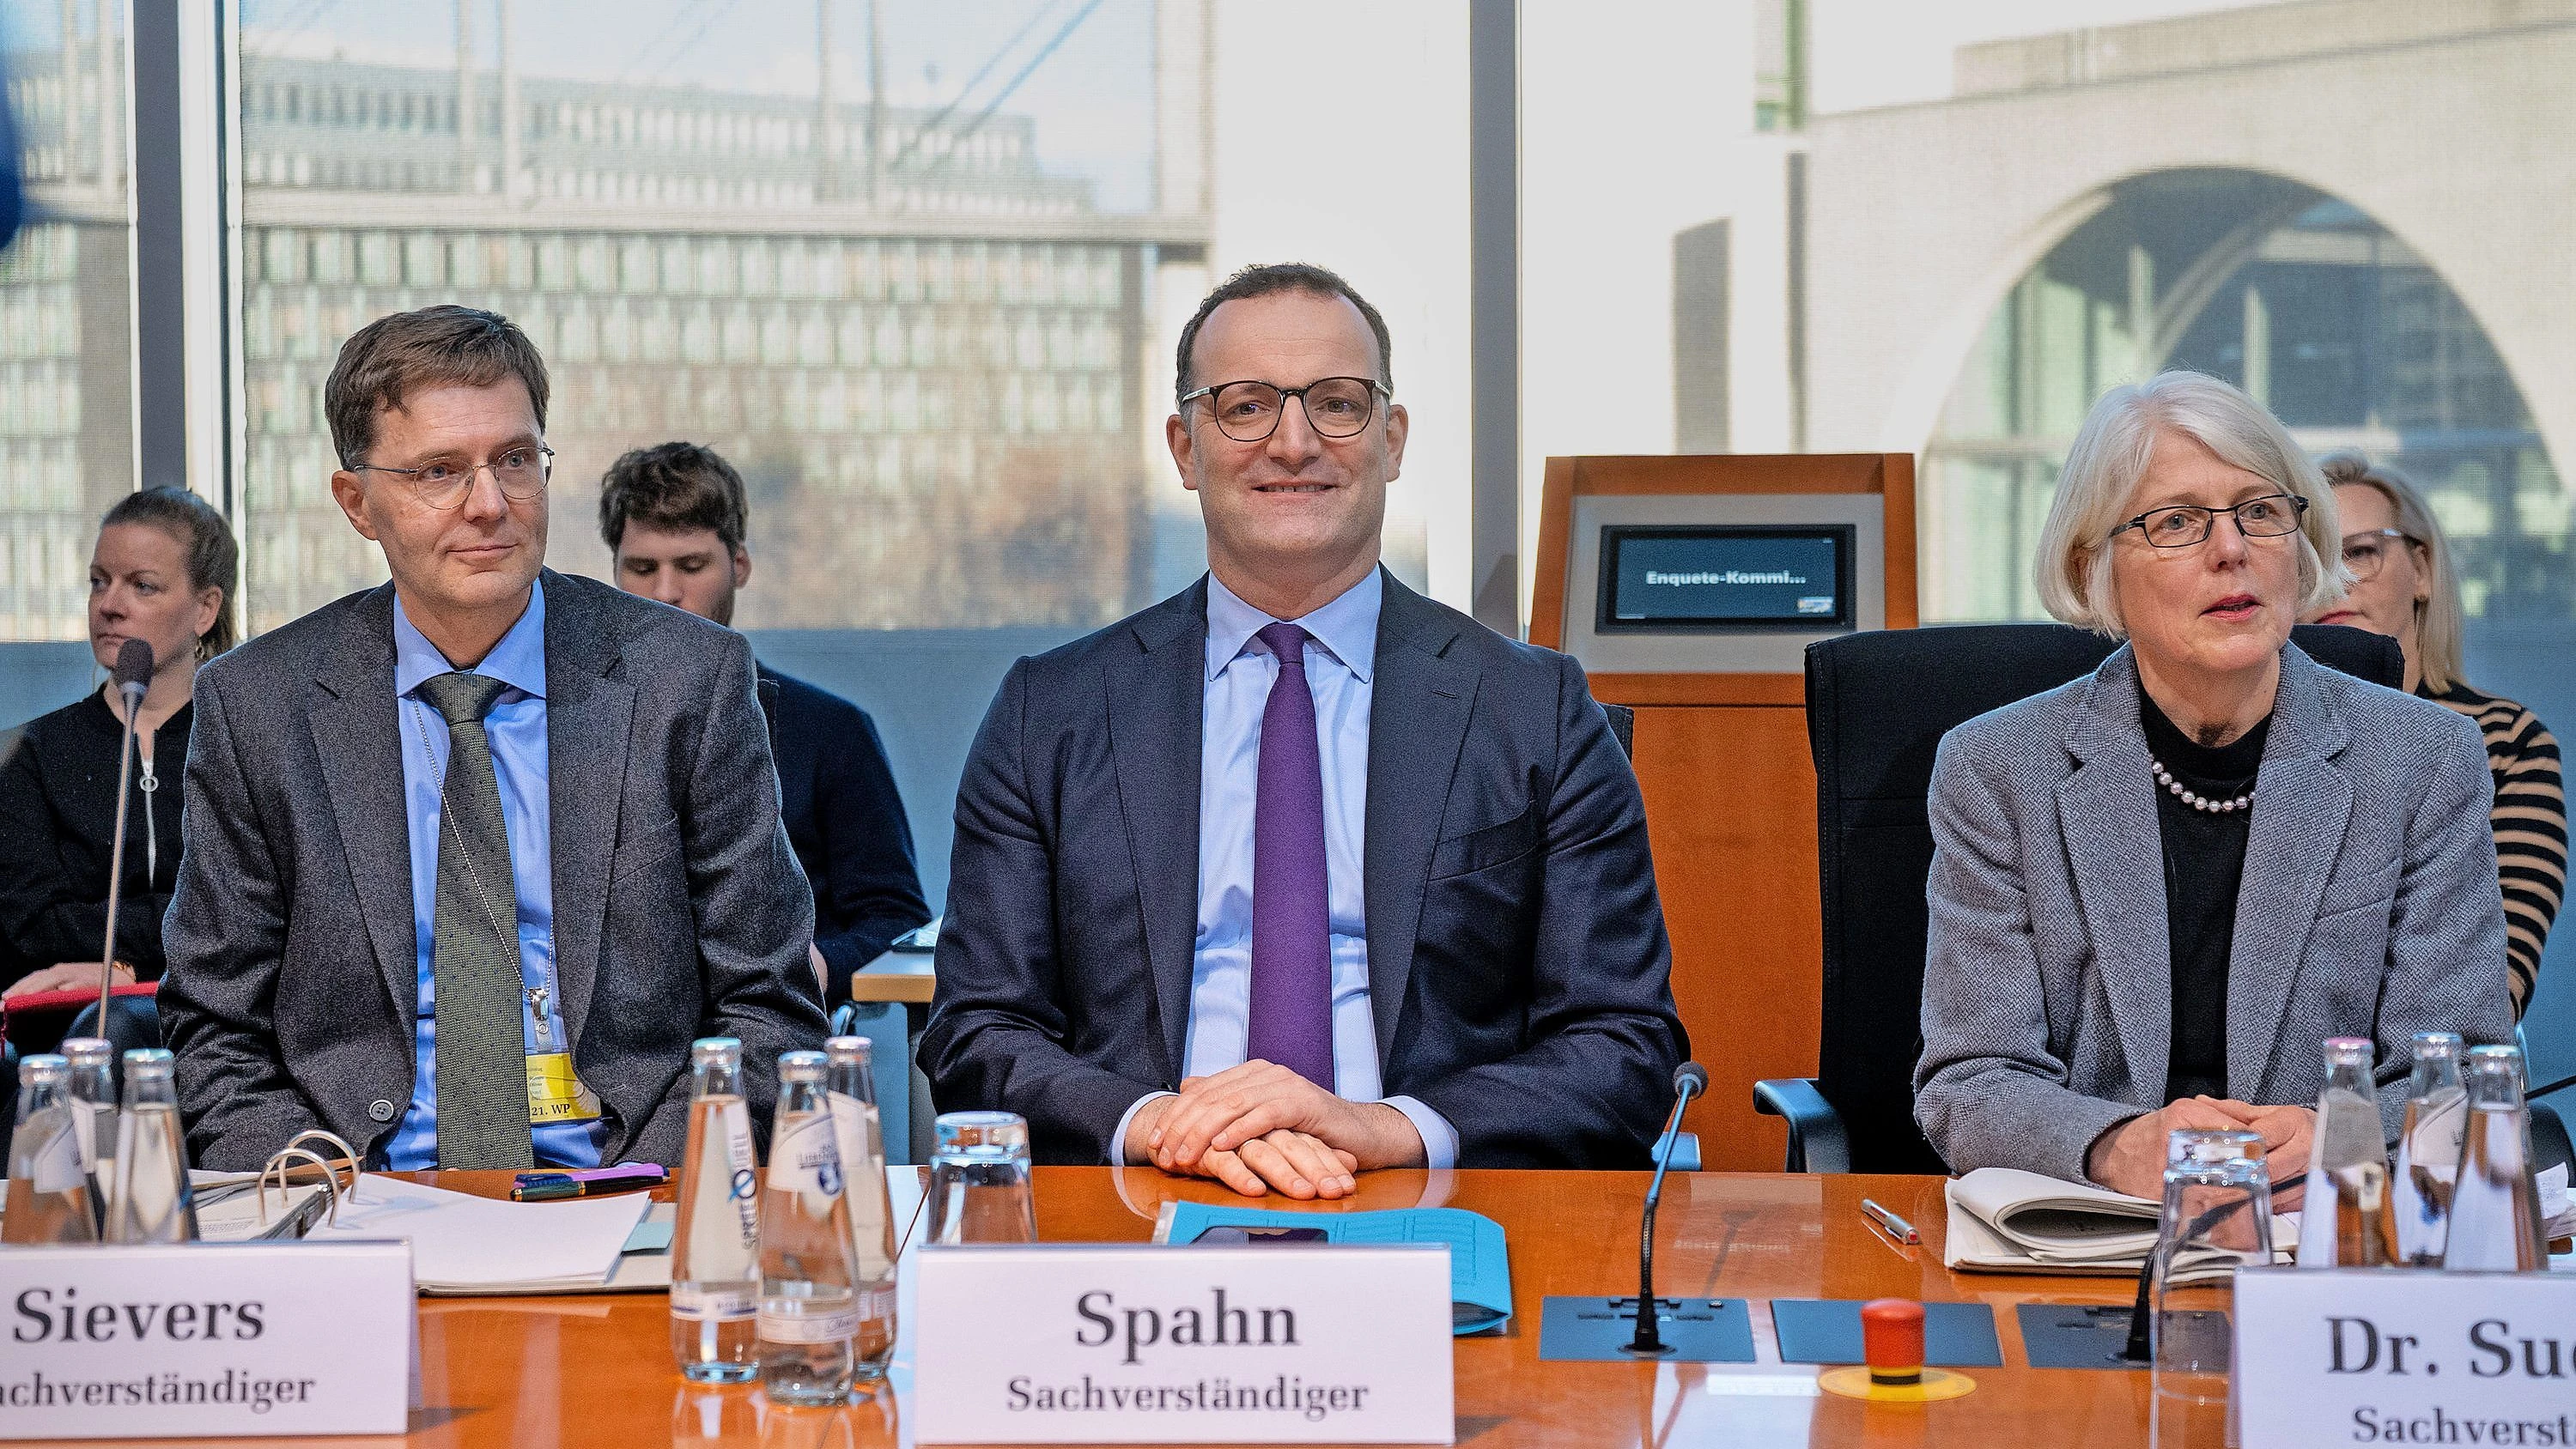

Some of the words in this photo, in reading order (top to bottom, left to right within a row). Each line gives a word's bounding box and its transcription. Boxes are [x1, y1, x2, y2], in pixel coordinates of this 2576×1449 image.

[1646, 570, 1806, 587] Enquete-Kommi...
[531, 1106, 549, 1116] 21.
[550, 1103, 571, 1114] WP
[13, 1286, 266, 1343] Sievers
[1075, 1286, 1301, 1366] Spahn
[2325, 1316, 2439, 1375] Dr.
[2470, 1319, 2576, 1379] Su
[1007, 1373, 1369, 1421] Sachverständiger
[2353, 1406, 2576, 1447] Sachverst
